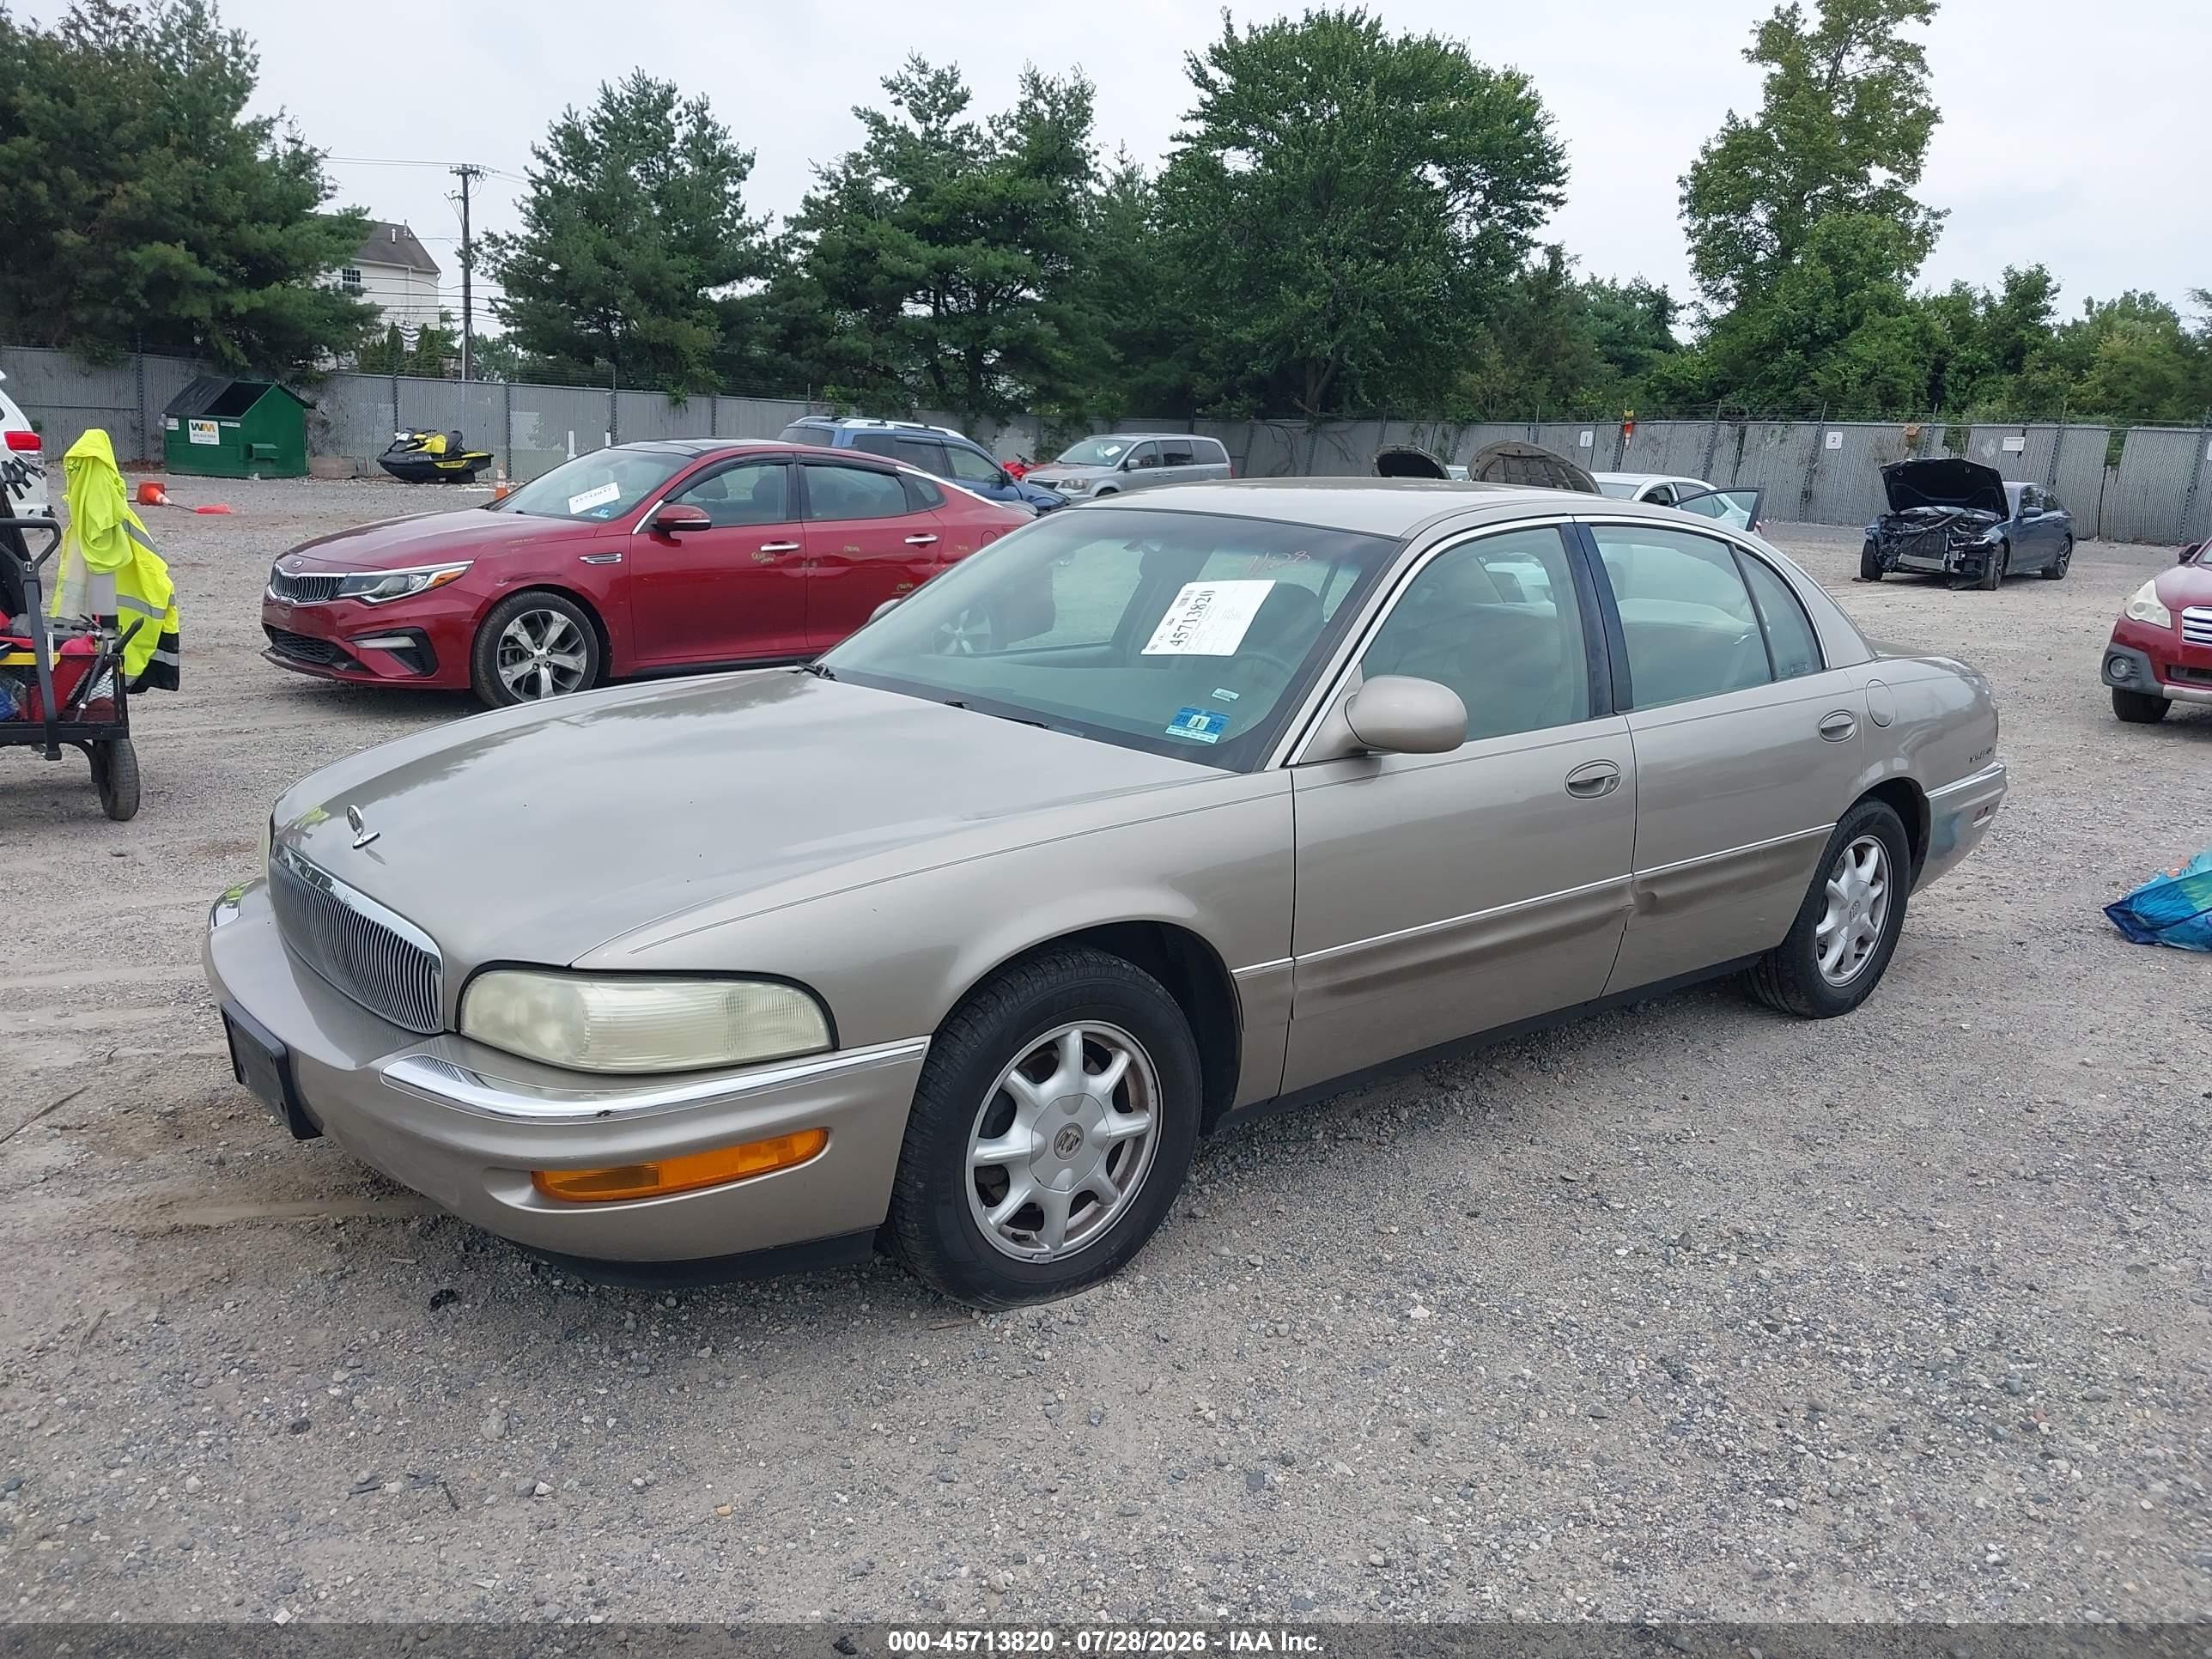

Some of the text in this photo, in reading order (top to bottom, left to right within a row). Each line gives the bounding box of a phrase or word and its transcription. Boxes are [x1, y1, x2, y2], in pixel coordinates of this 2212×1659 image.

[191, 422, 215, 432] WM
[1170, 590, 1216, 647] 45713820
[1193, 718, 1201, 728] 1
